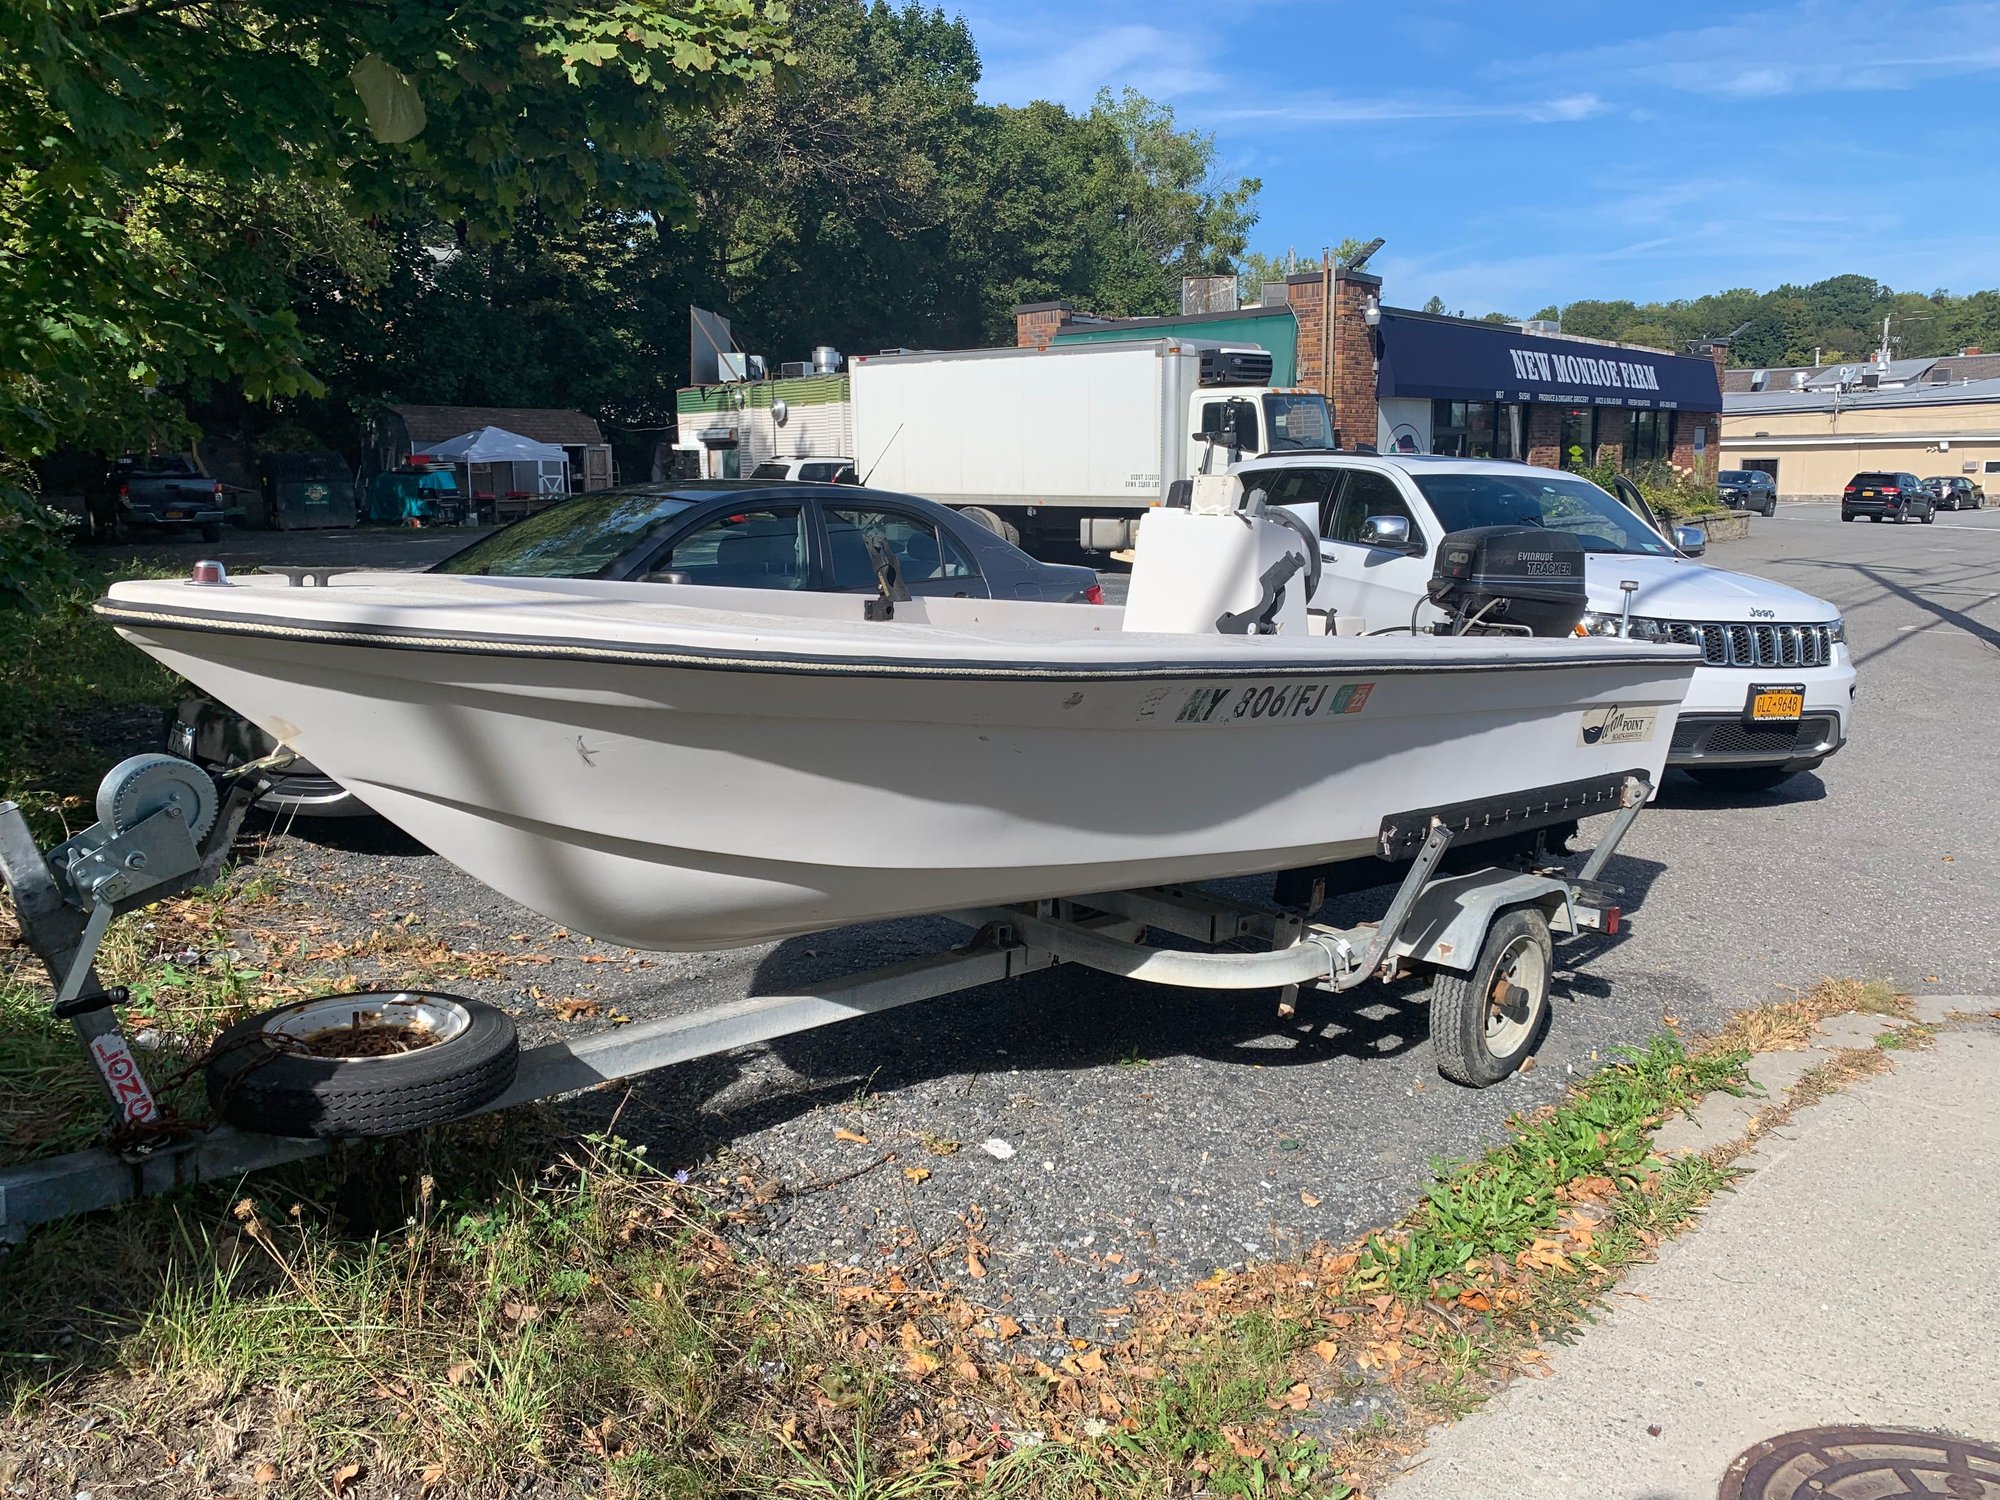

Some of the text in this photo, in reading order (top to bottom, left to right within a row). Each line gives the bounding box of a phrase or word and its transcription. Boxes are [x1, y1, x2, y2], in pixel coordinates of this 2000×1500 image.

[1510, 349, 1660, 391] NEW MONROE FARM
[1496, 390, 1504, 399] 687
[1519, 392, 1531, 400] SUSHI
[1538, 393, 1555, 402] PRODUCE
[1558, 395, 1573, 403] ORGANIC
[1448, 552, 1469, 564] 40
[1517, 551, 1554, 561] EVINRUDE
[1527, 561, 1571, 575] TRACKER
[1748, 607, 1775, 619] Jeep
[1622, 720, 1645, 731] POINT
